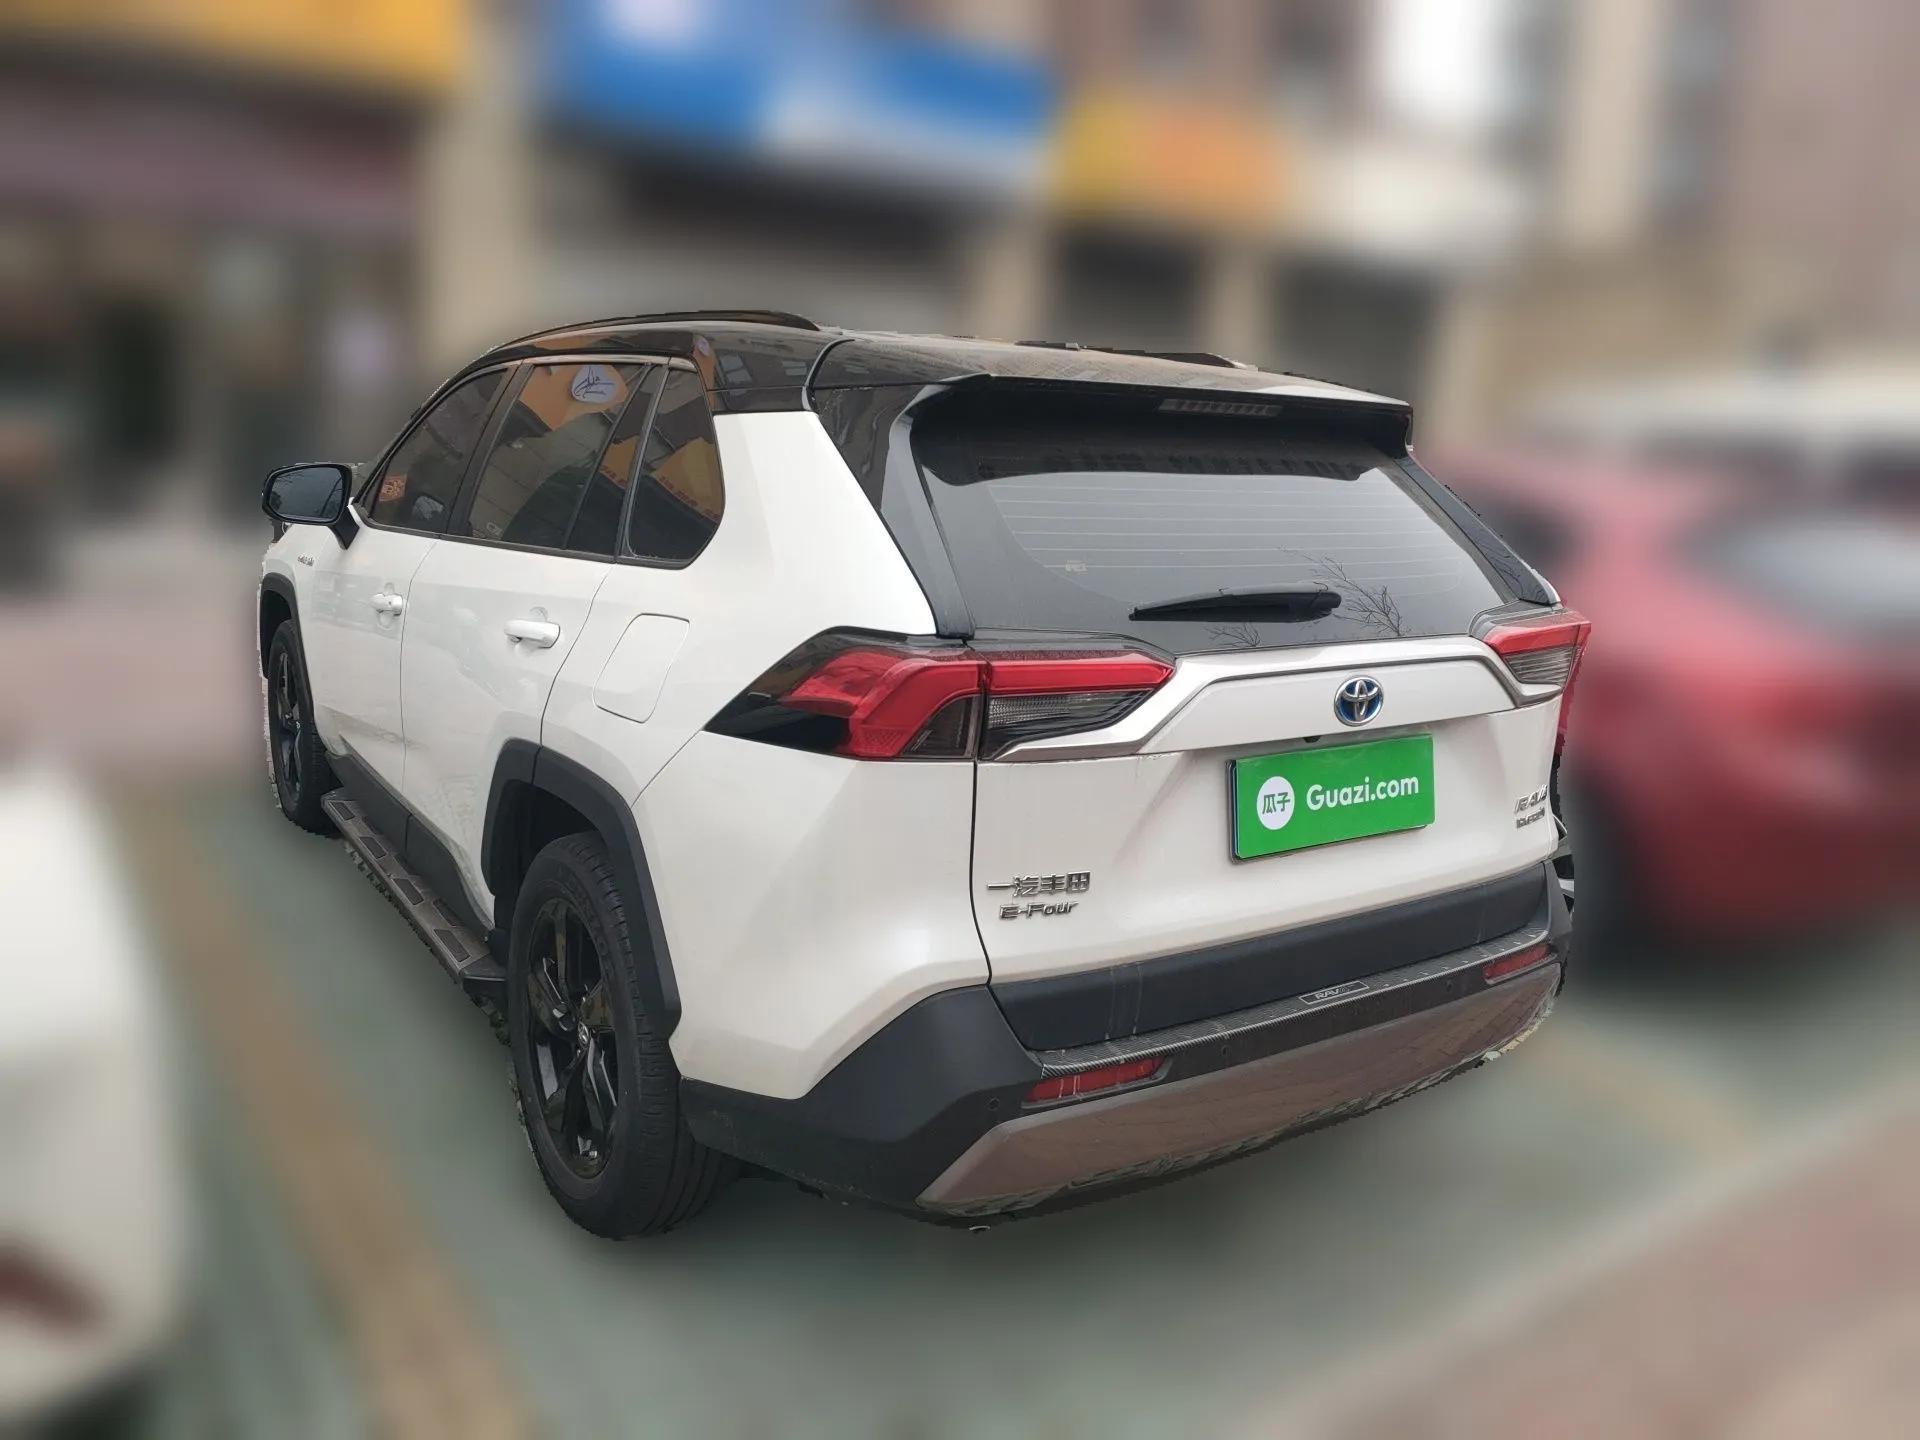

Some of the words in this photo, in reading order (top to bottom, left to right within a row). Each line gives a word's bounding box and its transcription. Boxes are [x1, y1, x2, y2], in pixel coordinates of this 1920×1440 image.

[1262, 792, 1291, 815] 瓜子
[1306, 776, 1419, 811] Guazi.com
[986, 871, 1091, 896] 一汽丰田
[1000, 901, 1079, 919] E-Four
